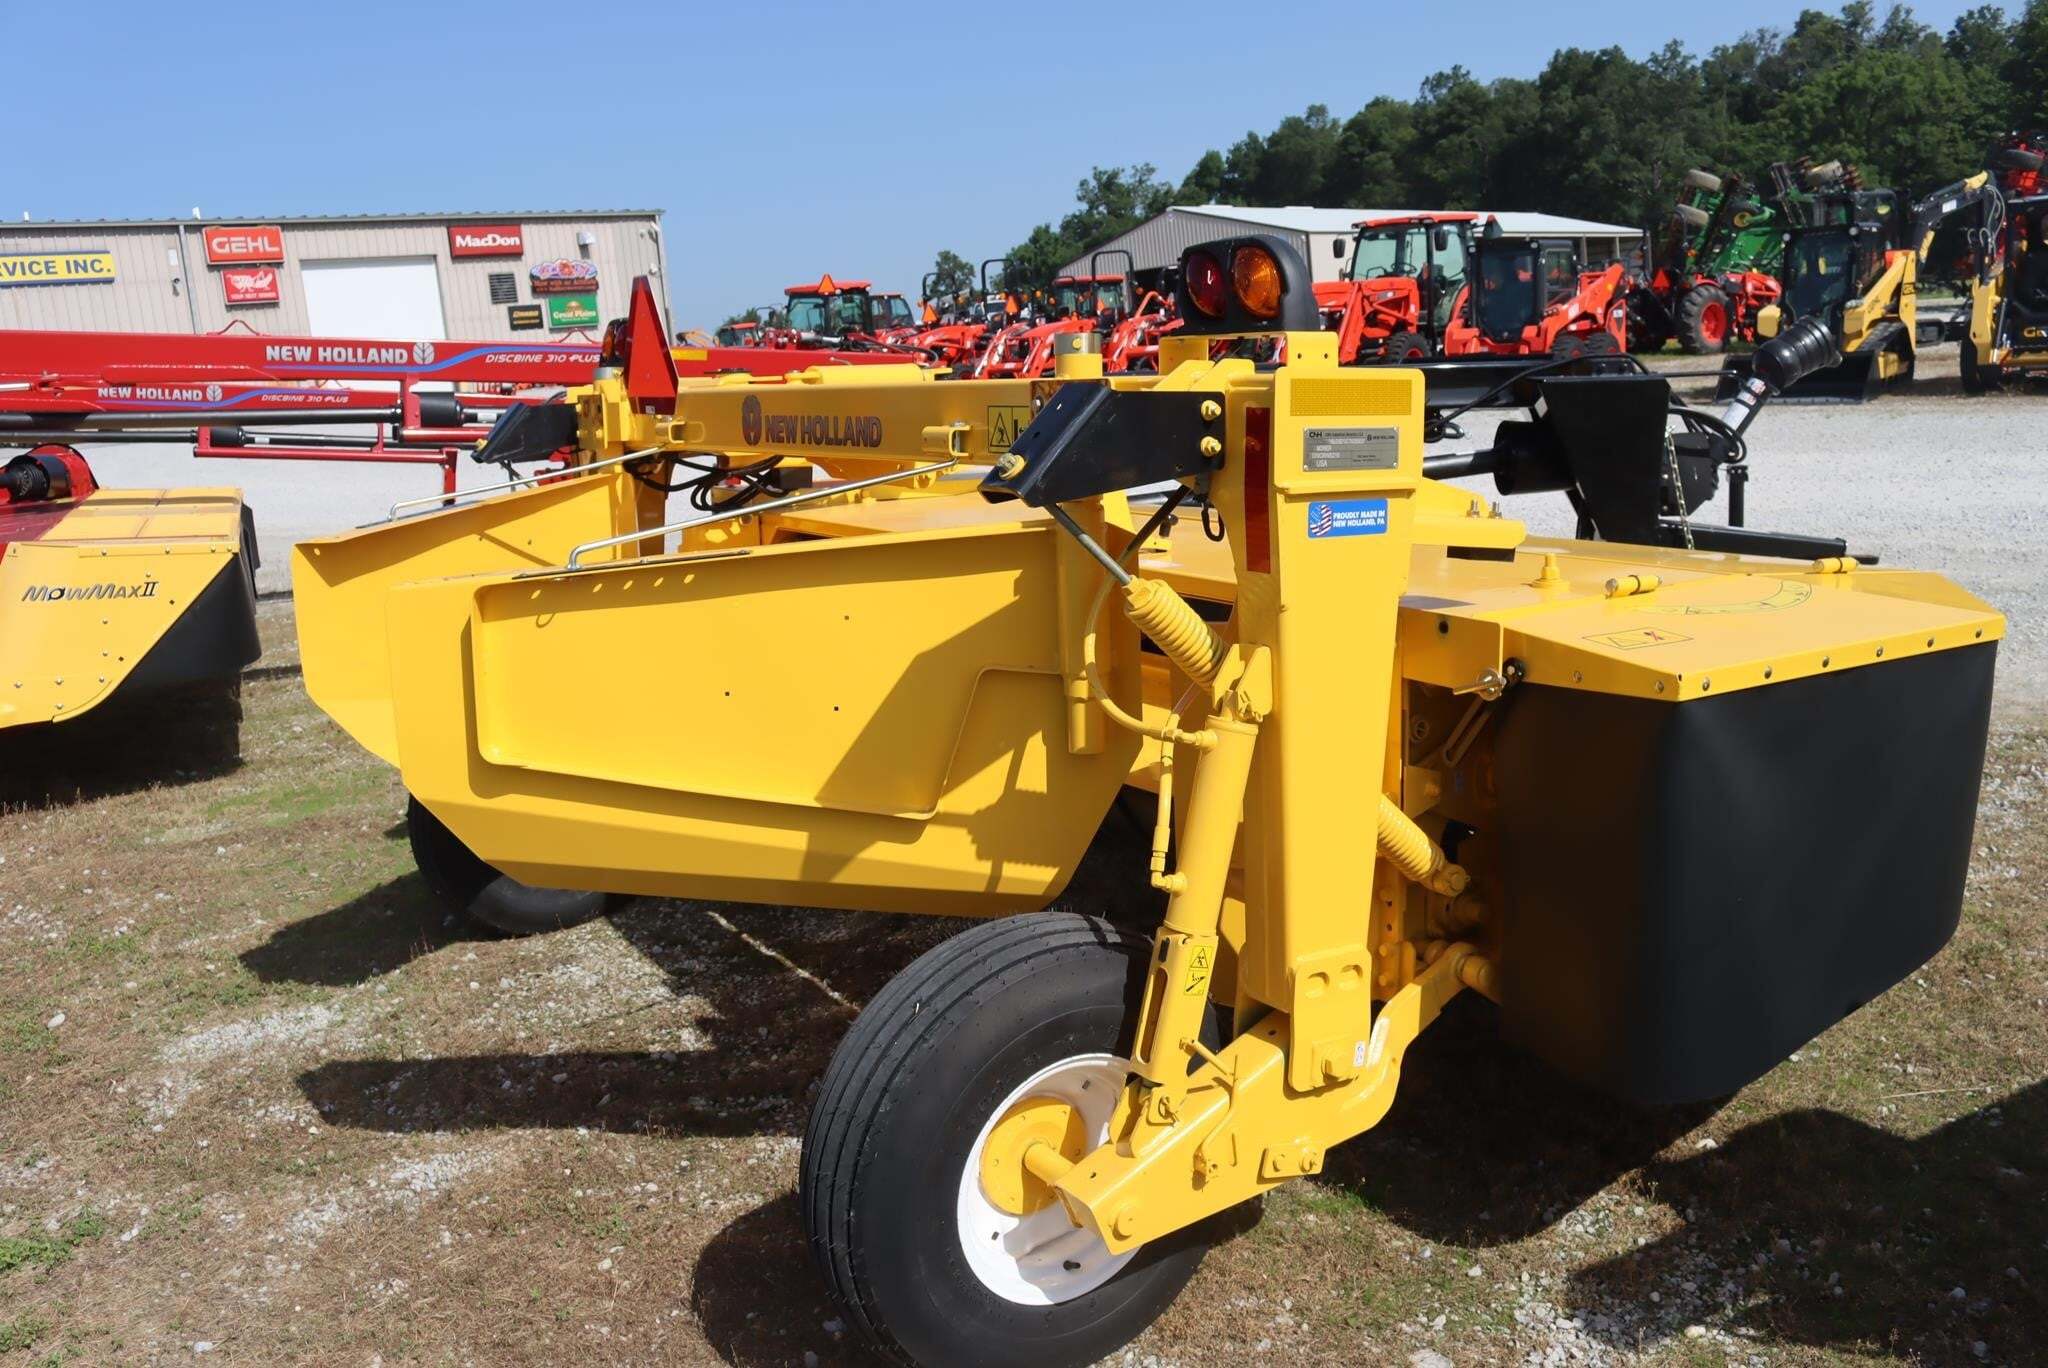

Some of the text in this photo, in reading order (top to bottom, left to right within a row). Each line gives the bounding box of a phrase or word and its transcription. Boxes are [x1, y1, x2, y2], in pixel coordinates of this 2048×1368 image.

[211, 236, 280, 253] GEHL
[455, 233, 520, 248] MacDon
[0, 258, 111, 277] VICE INC.
[266, 345, 408, 364] NEW HOLLAND
[485, 353, 543, 364] DISCBINE
[545, 353, 566, 363] 310
[98, 386, 203, 401] NEW HOLLAND
[262, 394, 304, 402] DISCBINE
[765, 414, 882, 447] NEW HOLLAND
